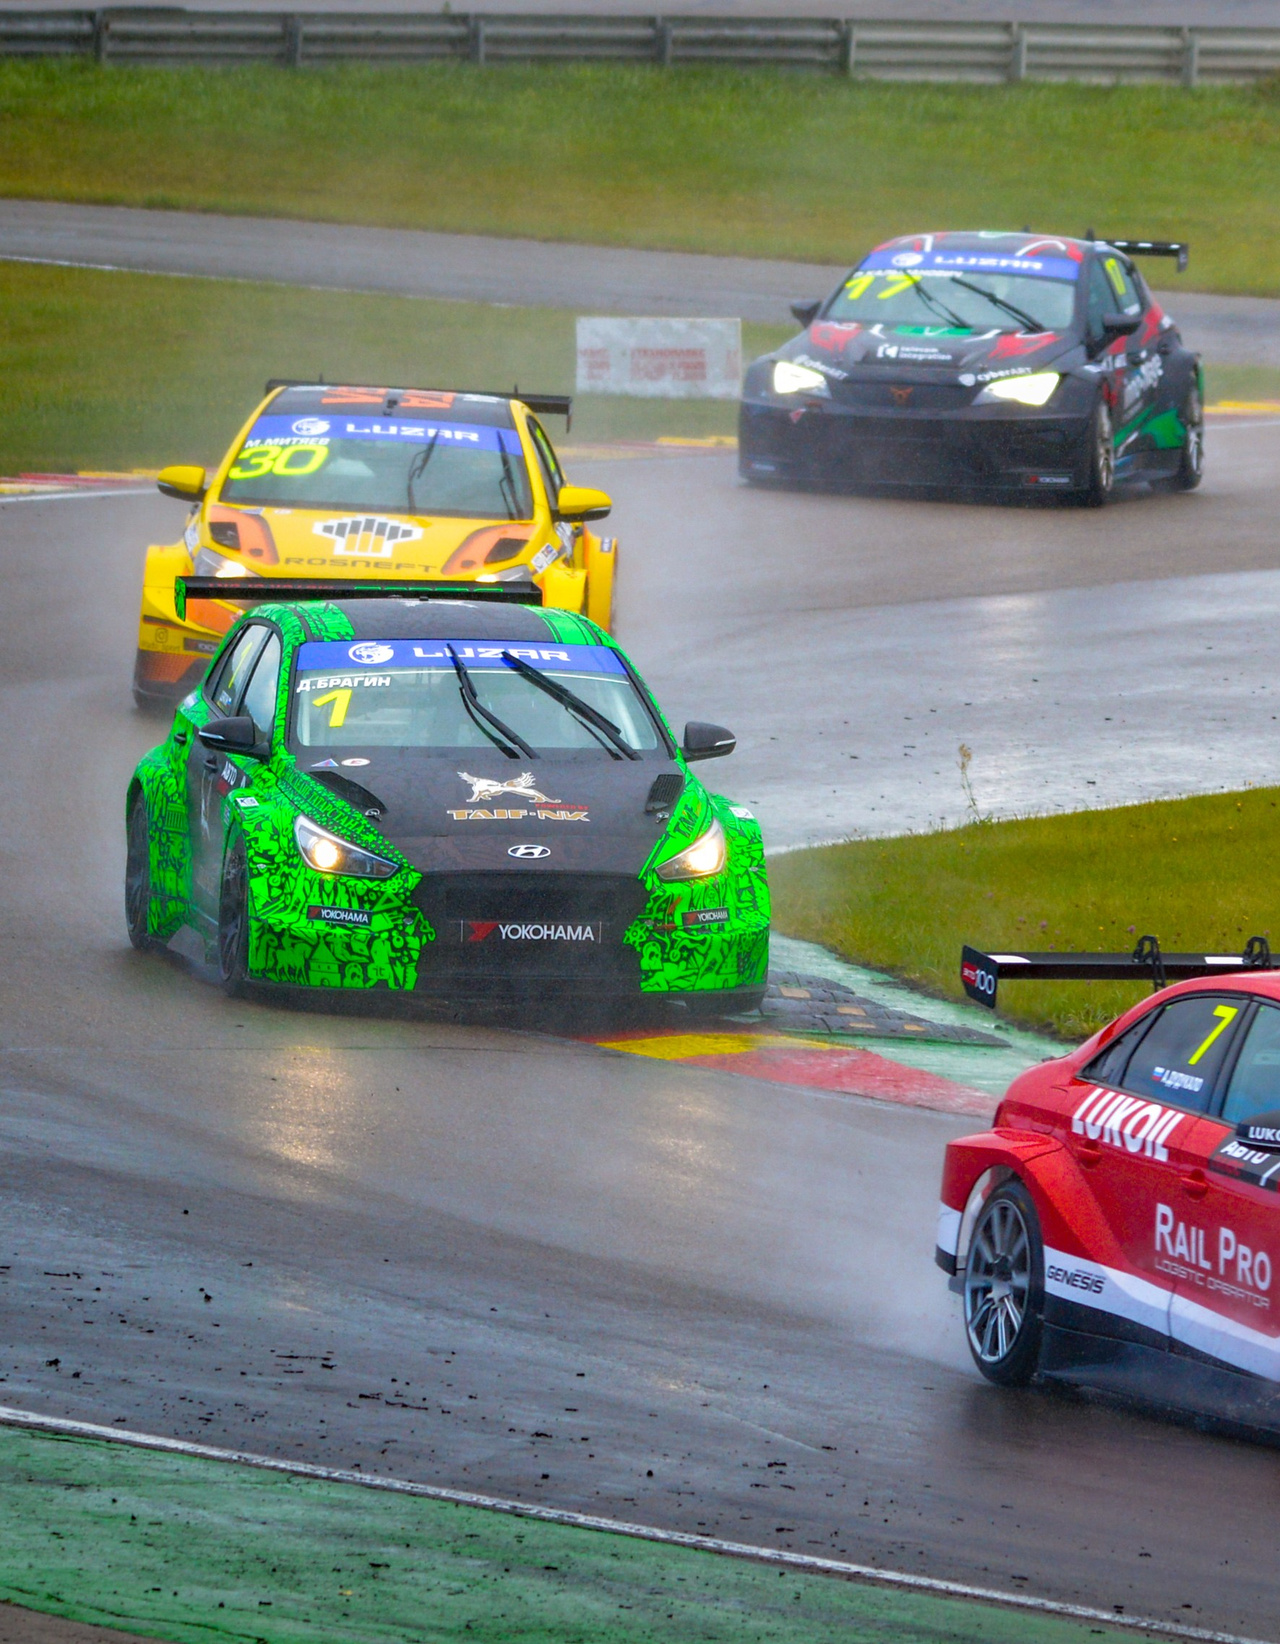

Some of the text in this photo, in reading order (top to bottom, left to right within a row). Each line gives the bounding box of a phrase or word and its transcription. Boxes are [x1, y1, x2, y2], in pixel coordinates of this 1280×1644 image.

[934, 256, 1044, 270] LUZAR
[845, 274, 924, 299] 17
[976, 366, 1033, 381] cyberART
[345, 422, 480, 442] LUZAR
[244, 437, 331, 449] М.МИТЯЕВ
[228, 444, 330, 481] 30
[283, 556, 438, 573] ROSNEFT
[412, 646, 572, 662] LUZAR
[296, 676, 391, 693] Д.БРАГИН
[312, 688, 353, 728] 1
[320, 908, 369, 924] YOKOHAMA
[697, 910, 729, 922] YOKOHAMA
[498, 924, 595, 941] YOKOHAMA
[1187, 1004, 1239, 1066] 7
[1070, 1087, 1186, 1163] LUKOIL
[1155, 1202, 1272, 1292] RAIL PRO
[1047, 1264, 1105, 1294] GENESIS
[1154, 1256, 1270, 1310] LOGISTIC OPERATOR
